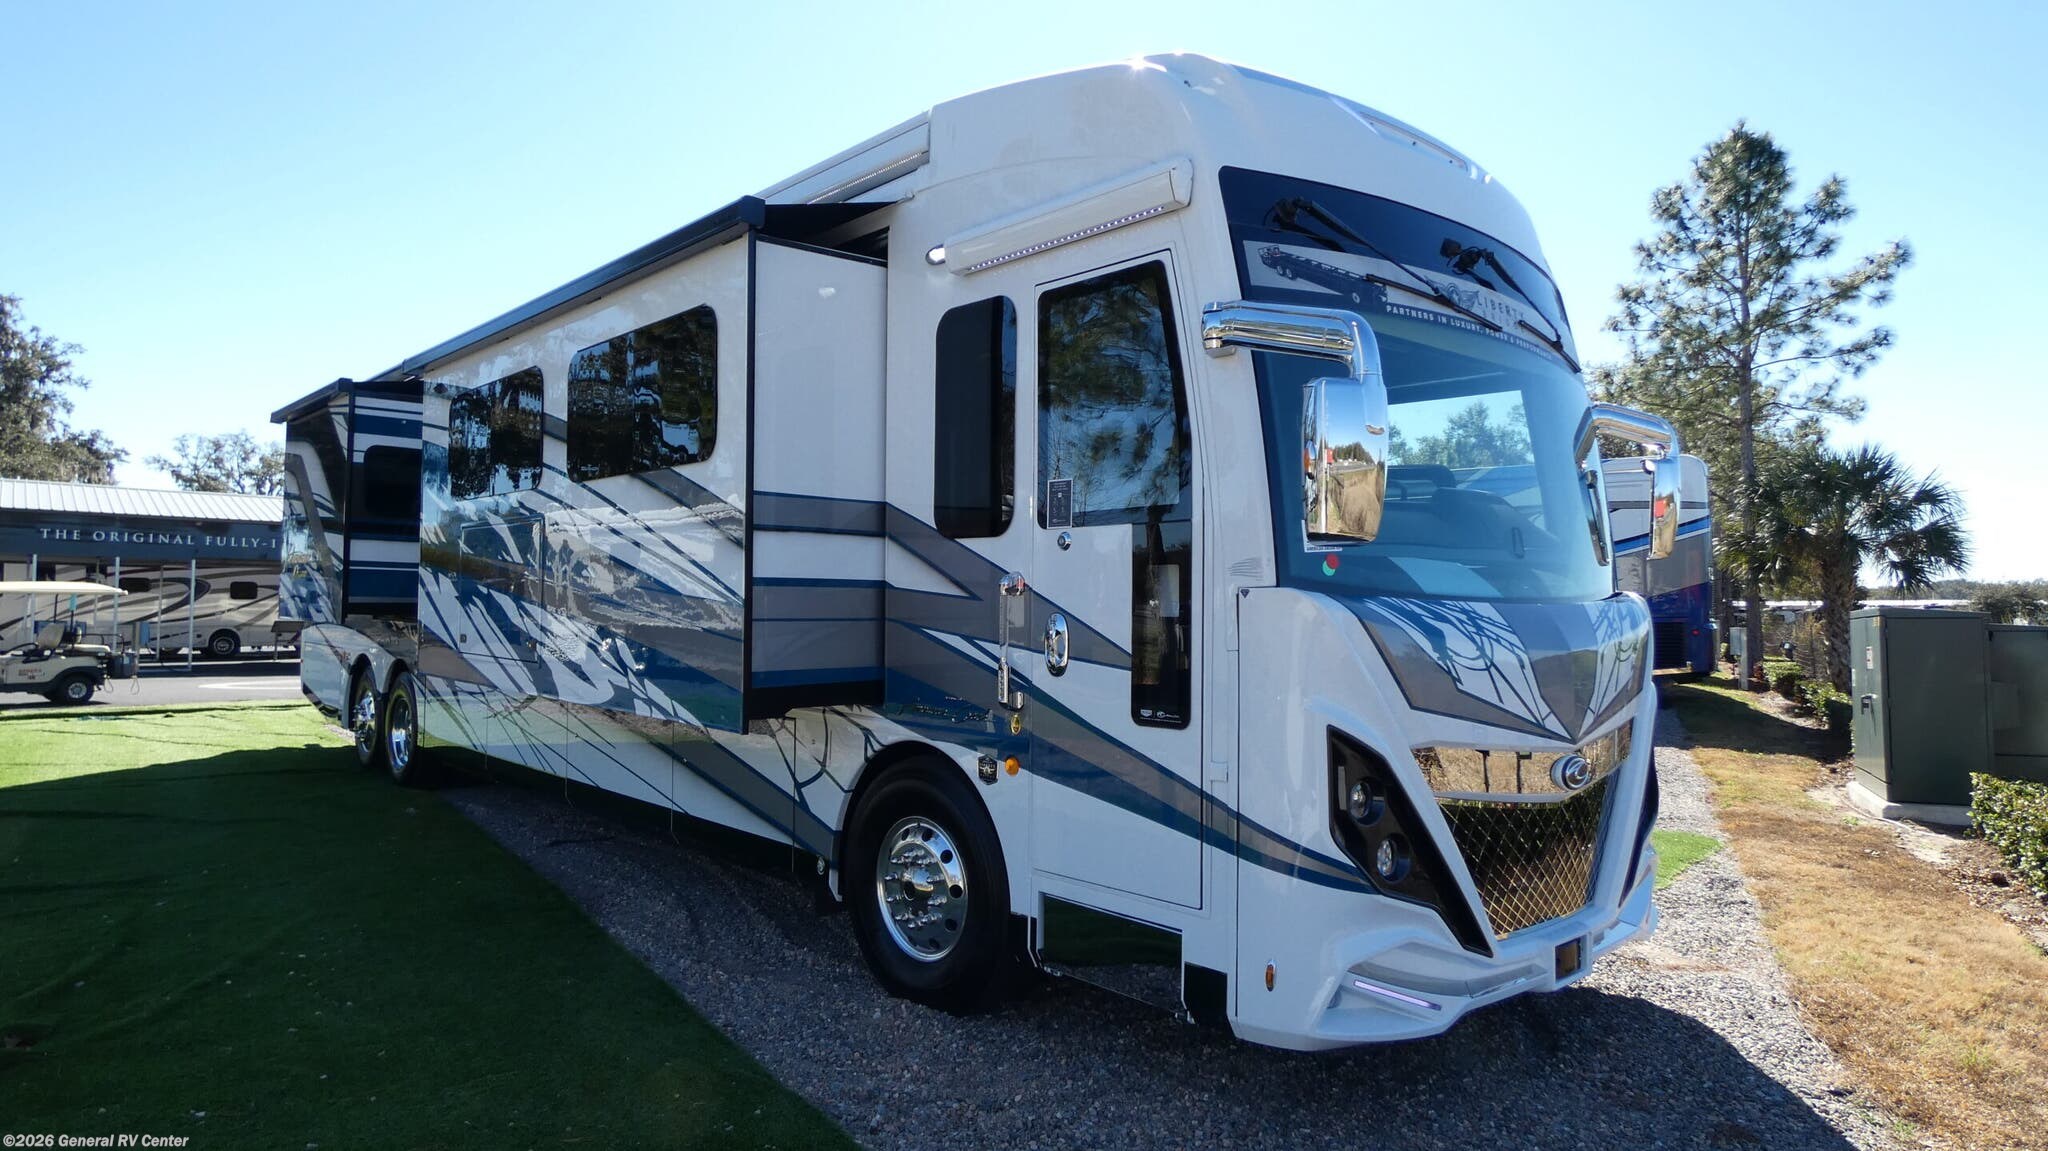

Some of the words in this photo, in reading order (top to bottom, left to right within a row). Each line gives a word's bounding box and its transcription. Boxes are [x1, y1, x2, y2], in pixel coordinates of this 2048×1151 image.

[1386, 304, 1434, 321] PARTNERS
[1437, 315, 1447, 324] IN
[1450, 318, 1484, 334] LUXURY,
[40, 528, 81, 541] THE
[93, 530, 195, 546] ORIGINAL
